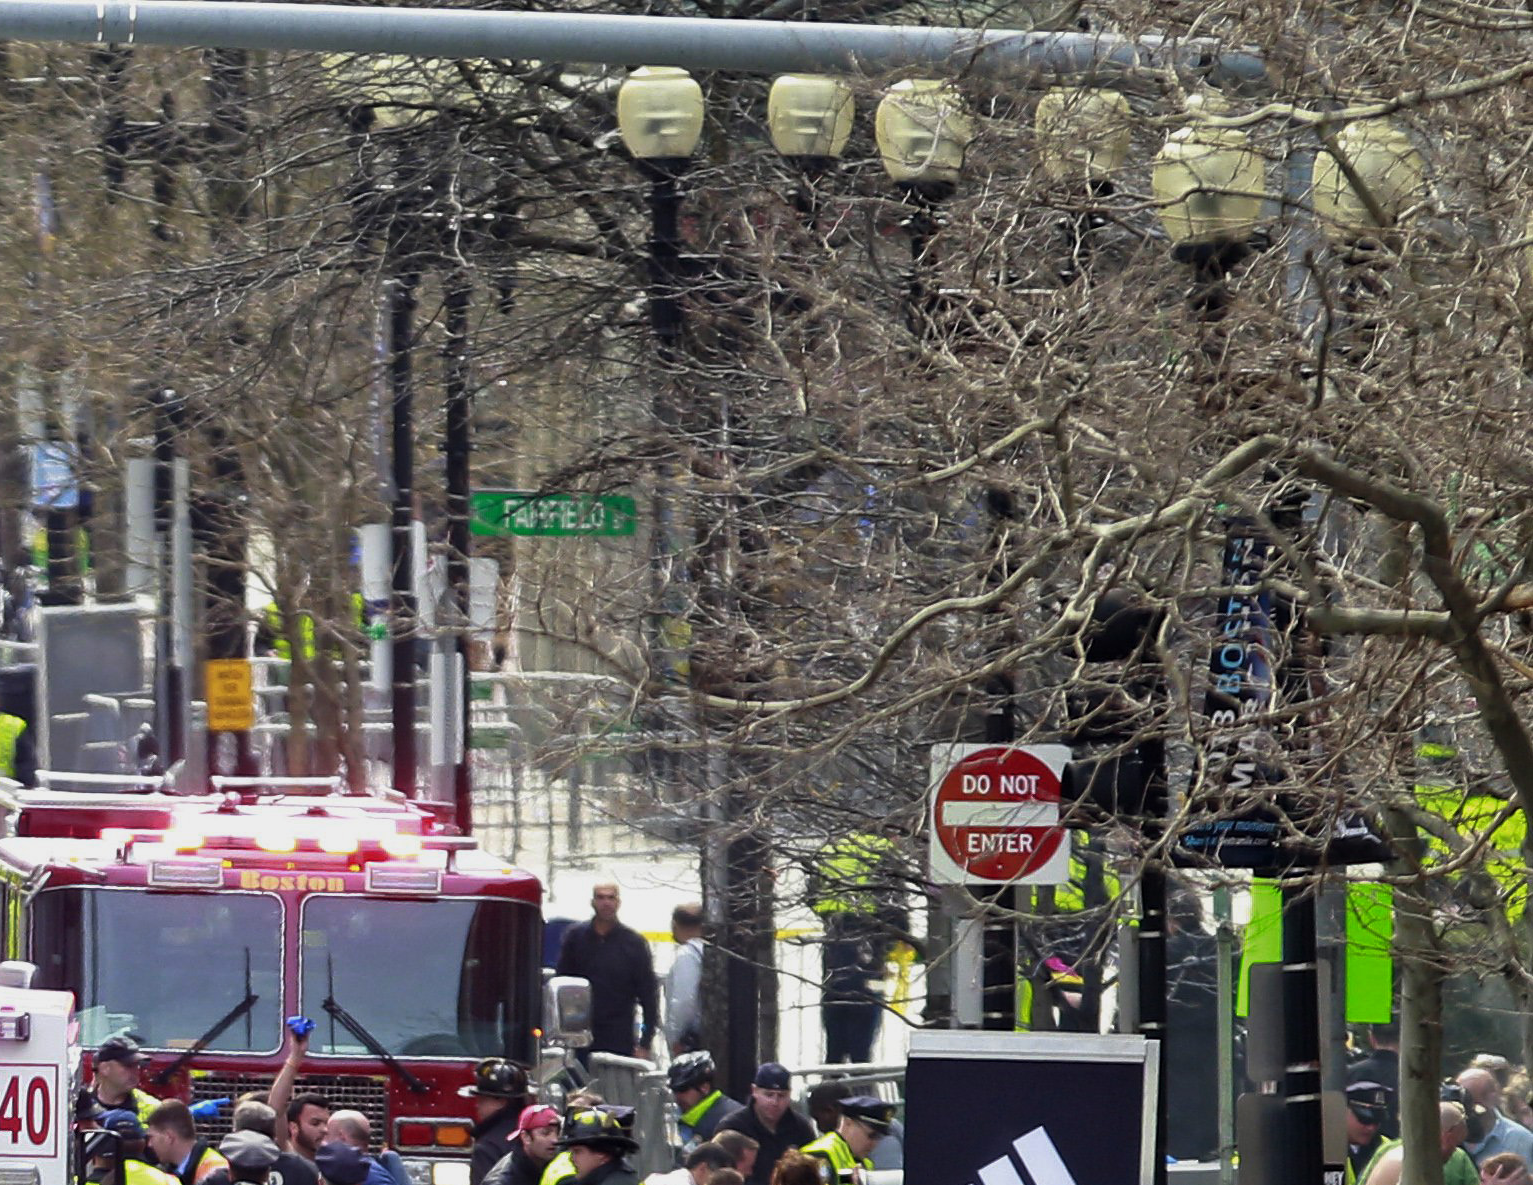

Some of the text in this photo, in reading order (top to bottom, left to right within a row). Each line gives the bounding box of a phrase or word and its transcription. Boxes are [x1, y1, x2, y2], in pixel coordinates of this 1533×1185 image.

[962, 774, 1041, 795] DO NOT
[967, 833, 1034, 853] ENTER
[240, 870, 345, 892] Boston
